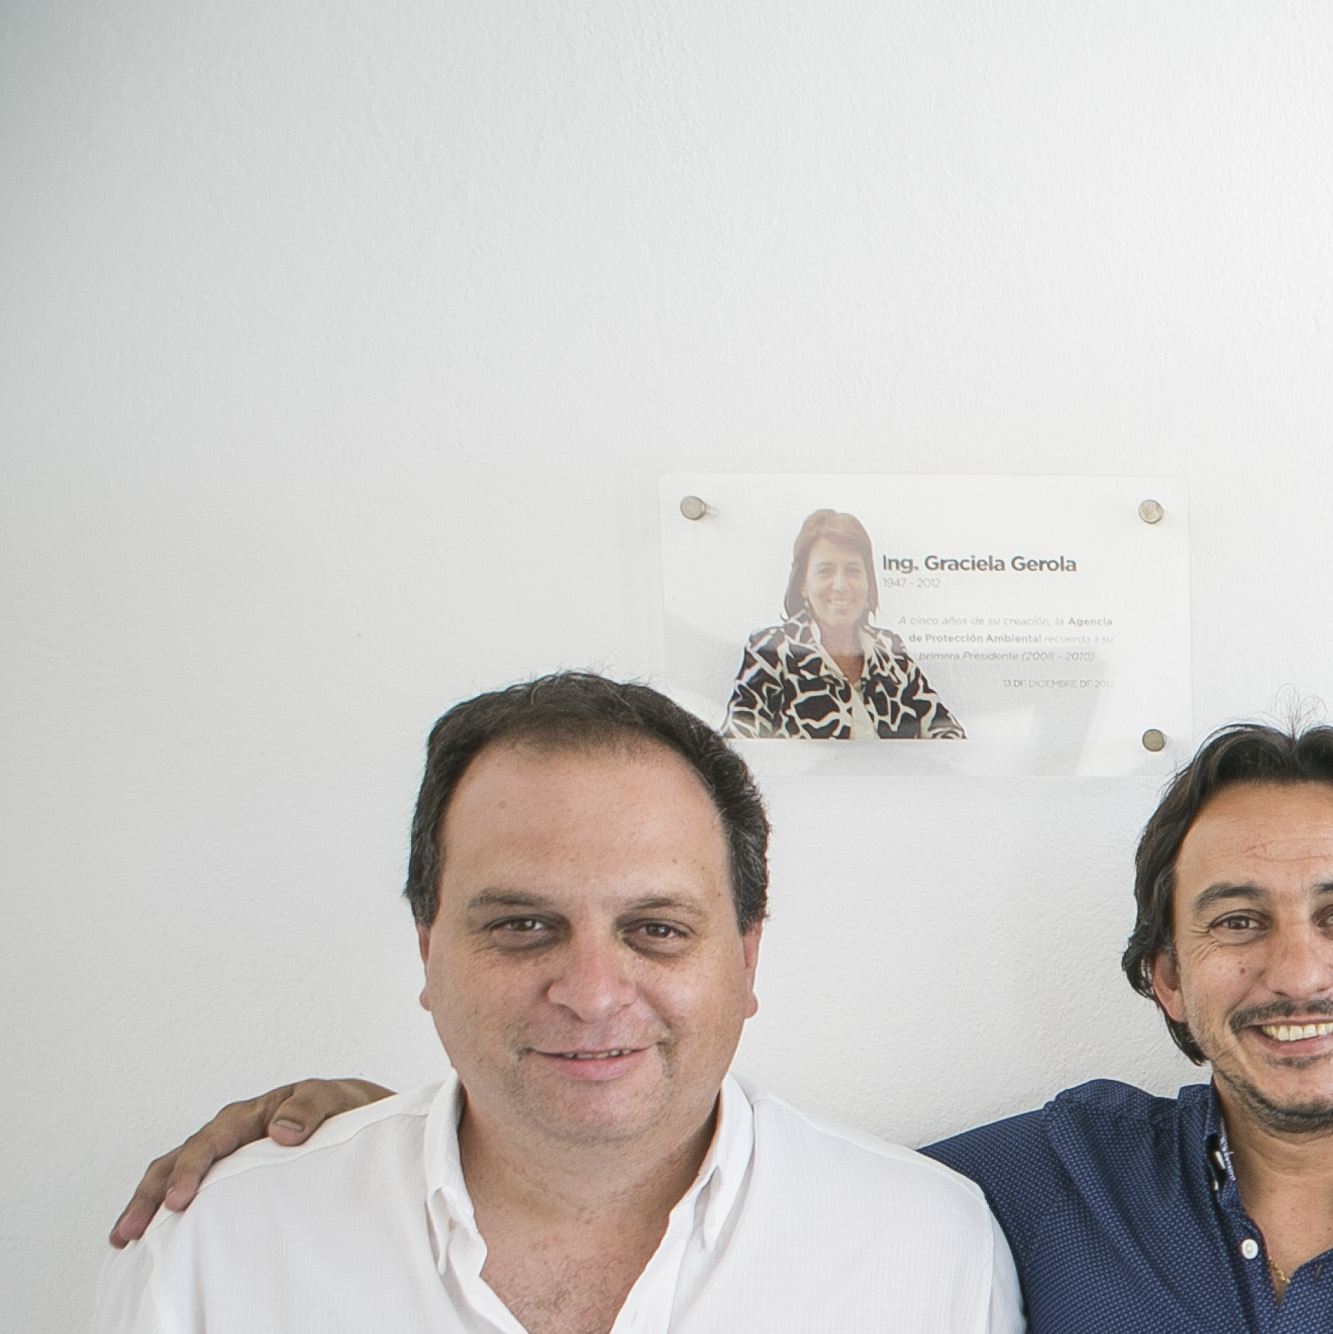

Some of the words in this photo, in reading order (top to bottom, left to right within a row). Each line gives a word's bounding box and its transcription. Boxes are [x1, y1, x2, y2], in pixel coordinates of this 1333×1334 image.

[882, 555, 919, 574] Ing.
[924, 555, 1005, 572] Graciela
[1010, 555, 1077, 572] Gerola
[883, 577, 907, 588] 1947
[916, 577, 941, 589] 2012
[910, 616, 939, 625] cinco
[942, 615, 967, 625] años
[971, 616, 985, 625] de
[988, 617, 1000, 625] su
[1067, 616, 1113, 627] Agencia
[909, 633, 923, 643] de
[925, 633, 983, 643] Protección
[986, 633, 1042, 643] Ambiental
[918, 651, 960, 661] primera
[962, 651, 1019, 661] Presidente
